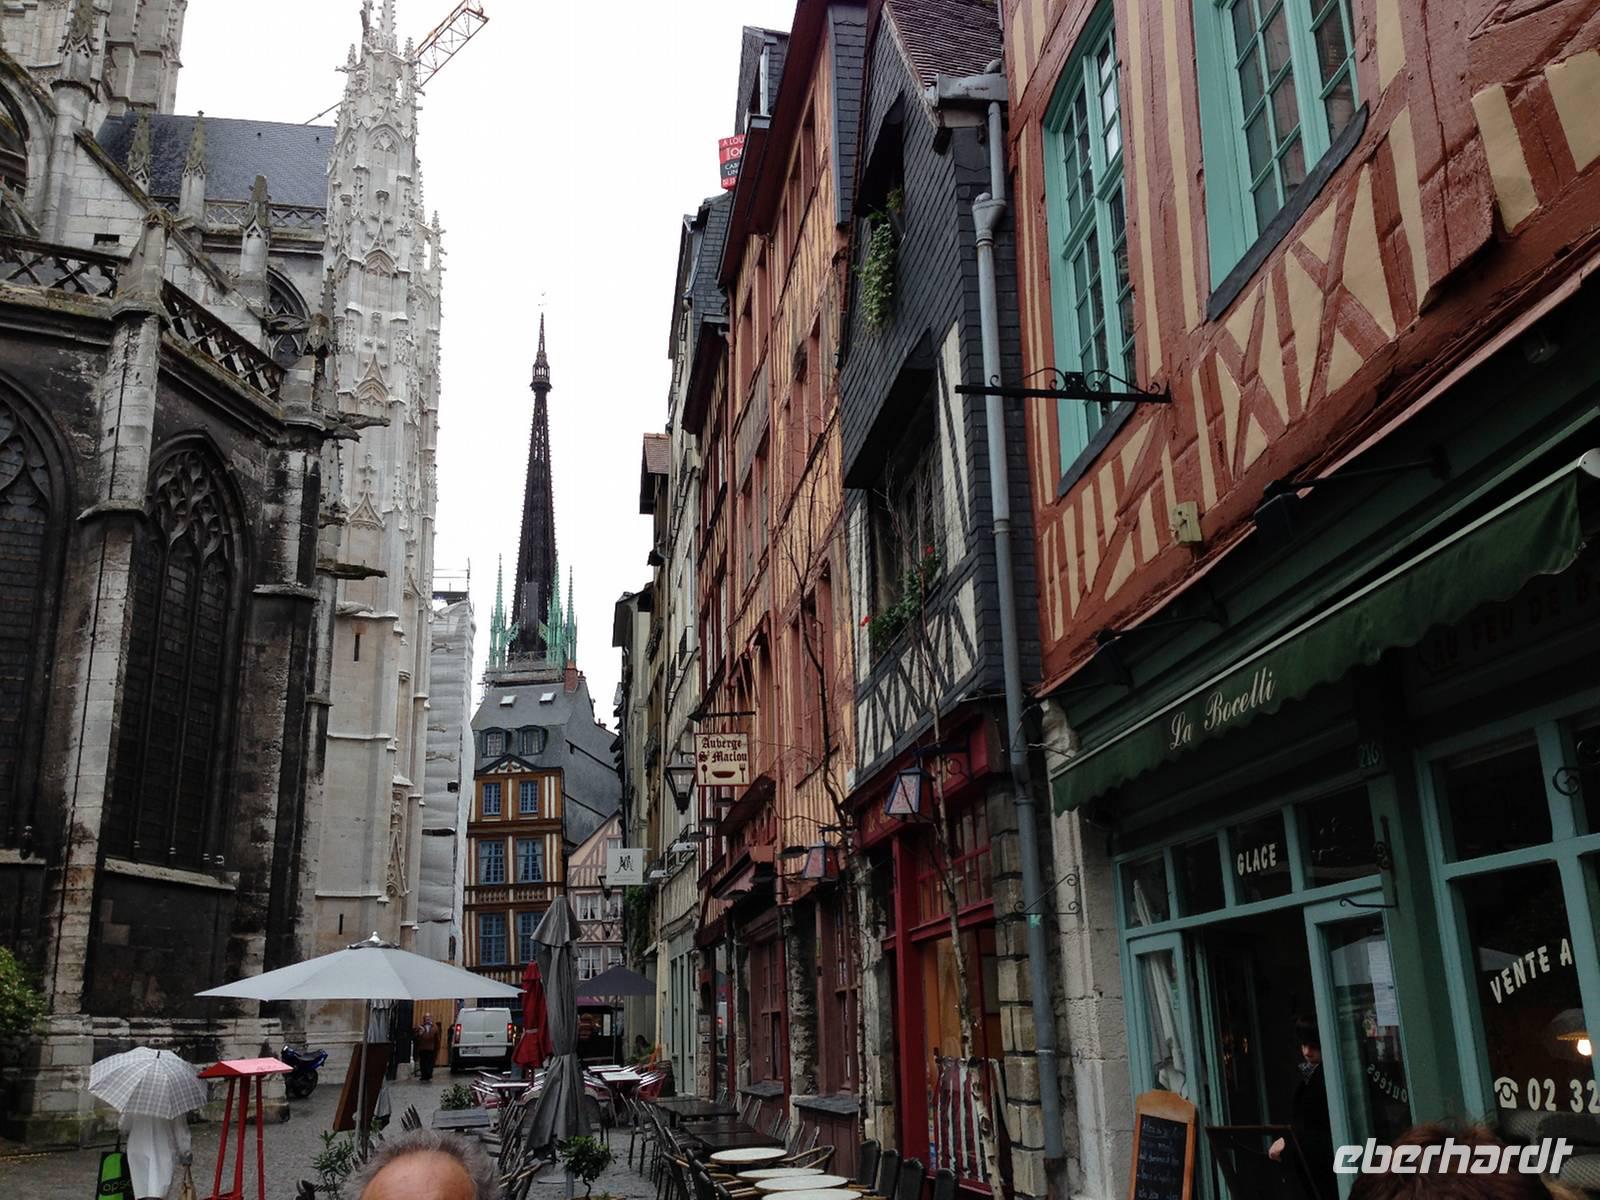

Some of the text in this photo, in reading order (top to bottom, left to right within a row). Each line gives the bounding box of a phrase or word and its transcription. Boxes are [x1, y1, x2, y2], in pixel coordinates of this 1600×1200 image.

[1169, 666, 1277, 751] La Bocelli
[702, 737, 741, 750] Auberge
[711, 750, 748, 763] Maclou
[1237, 843, 1276, 876] GLACE
[1490, 938, 1573, 1004] VENTE A
[1527, 1077, 1600, 1114] 02 32
